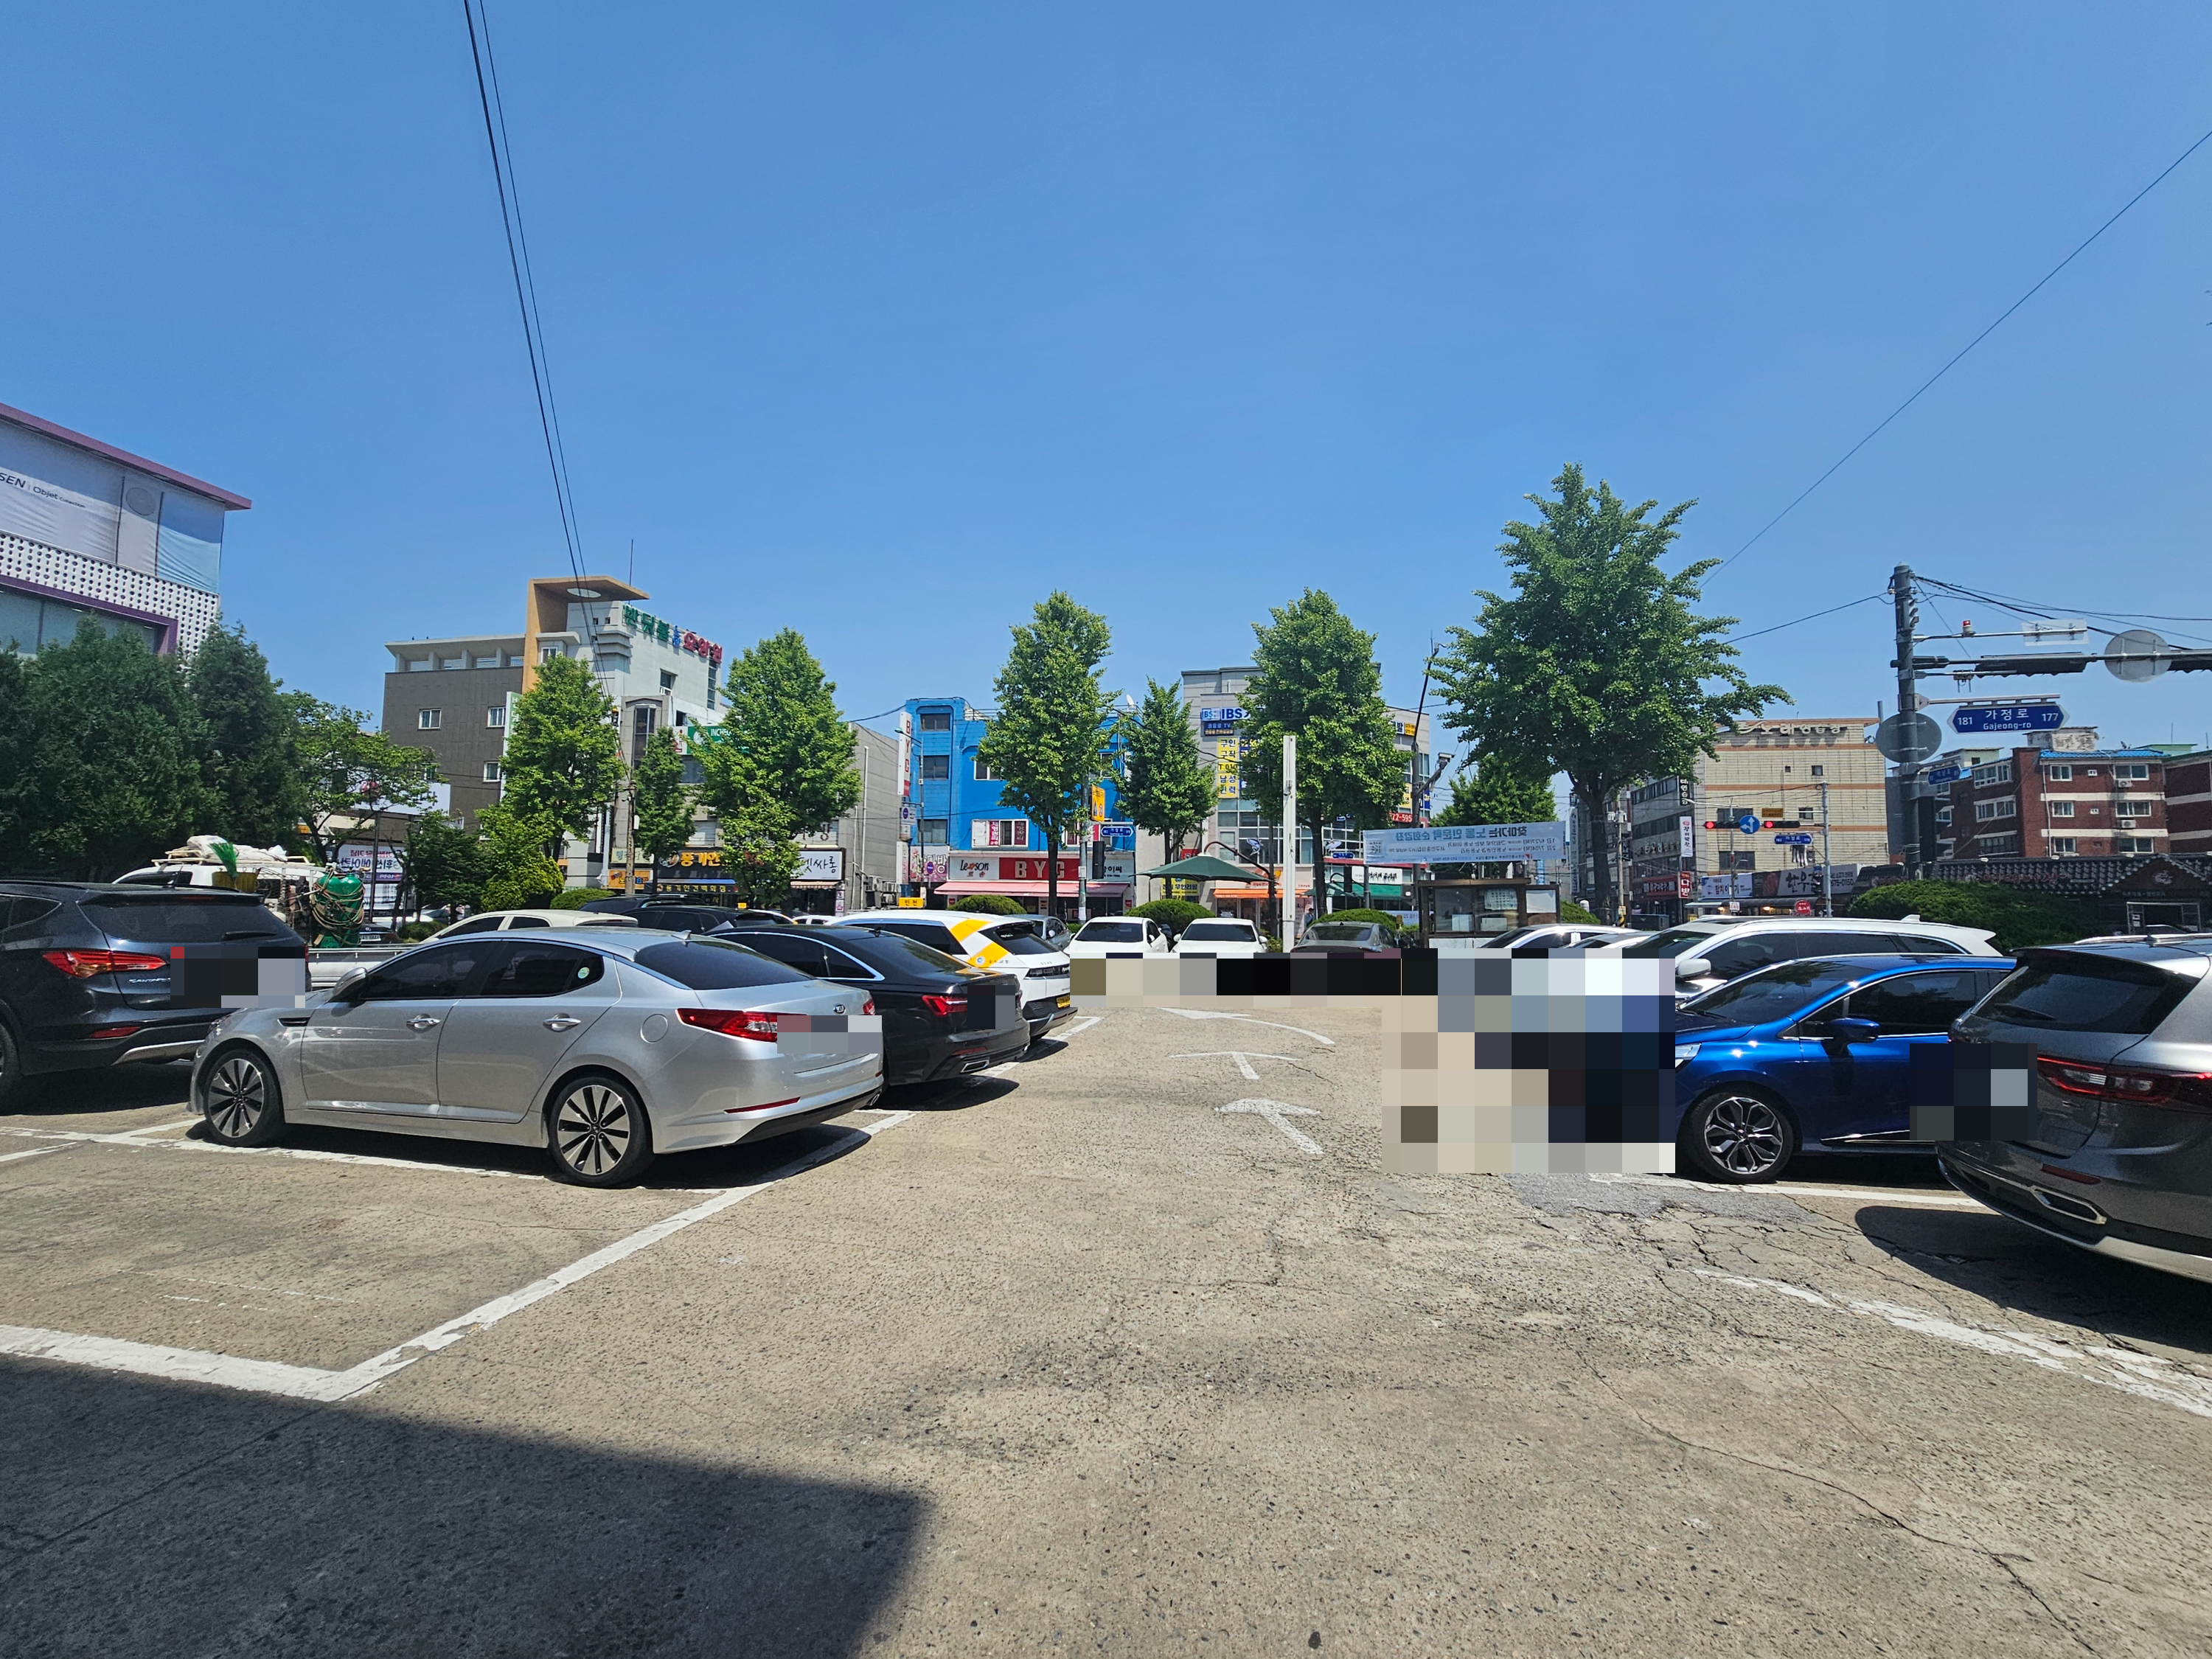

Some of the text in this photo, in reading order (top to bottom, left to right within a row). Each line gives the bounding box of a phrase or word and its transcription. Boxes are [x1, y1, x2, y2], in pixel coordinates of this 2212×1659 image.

[33, 487, 58, 500] Objet
[684, 632, 723, 664] 요양원
[1222, 709, 1242, 719] IBS
[1985, 708, 2030, 721] 가정로
[2041, 712, 2059, 722] 177
[1957, 717, 1973, 726] 181
[1983, 721, 2032, 731] Gajeong-ro
[1220, 740, 1236, 748] 구인
[1220, 751, 1236, 759] 구직
[1220, 776, 1236, 784] 남성
[680, 852, 726, 866] 풍기인
[1015, 860, 1065, 879] BYC
[904, 899, 918, 907] 인천
